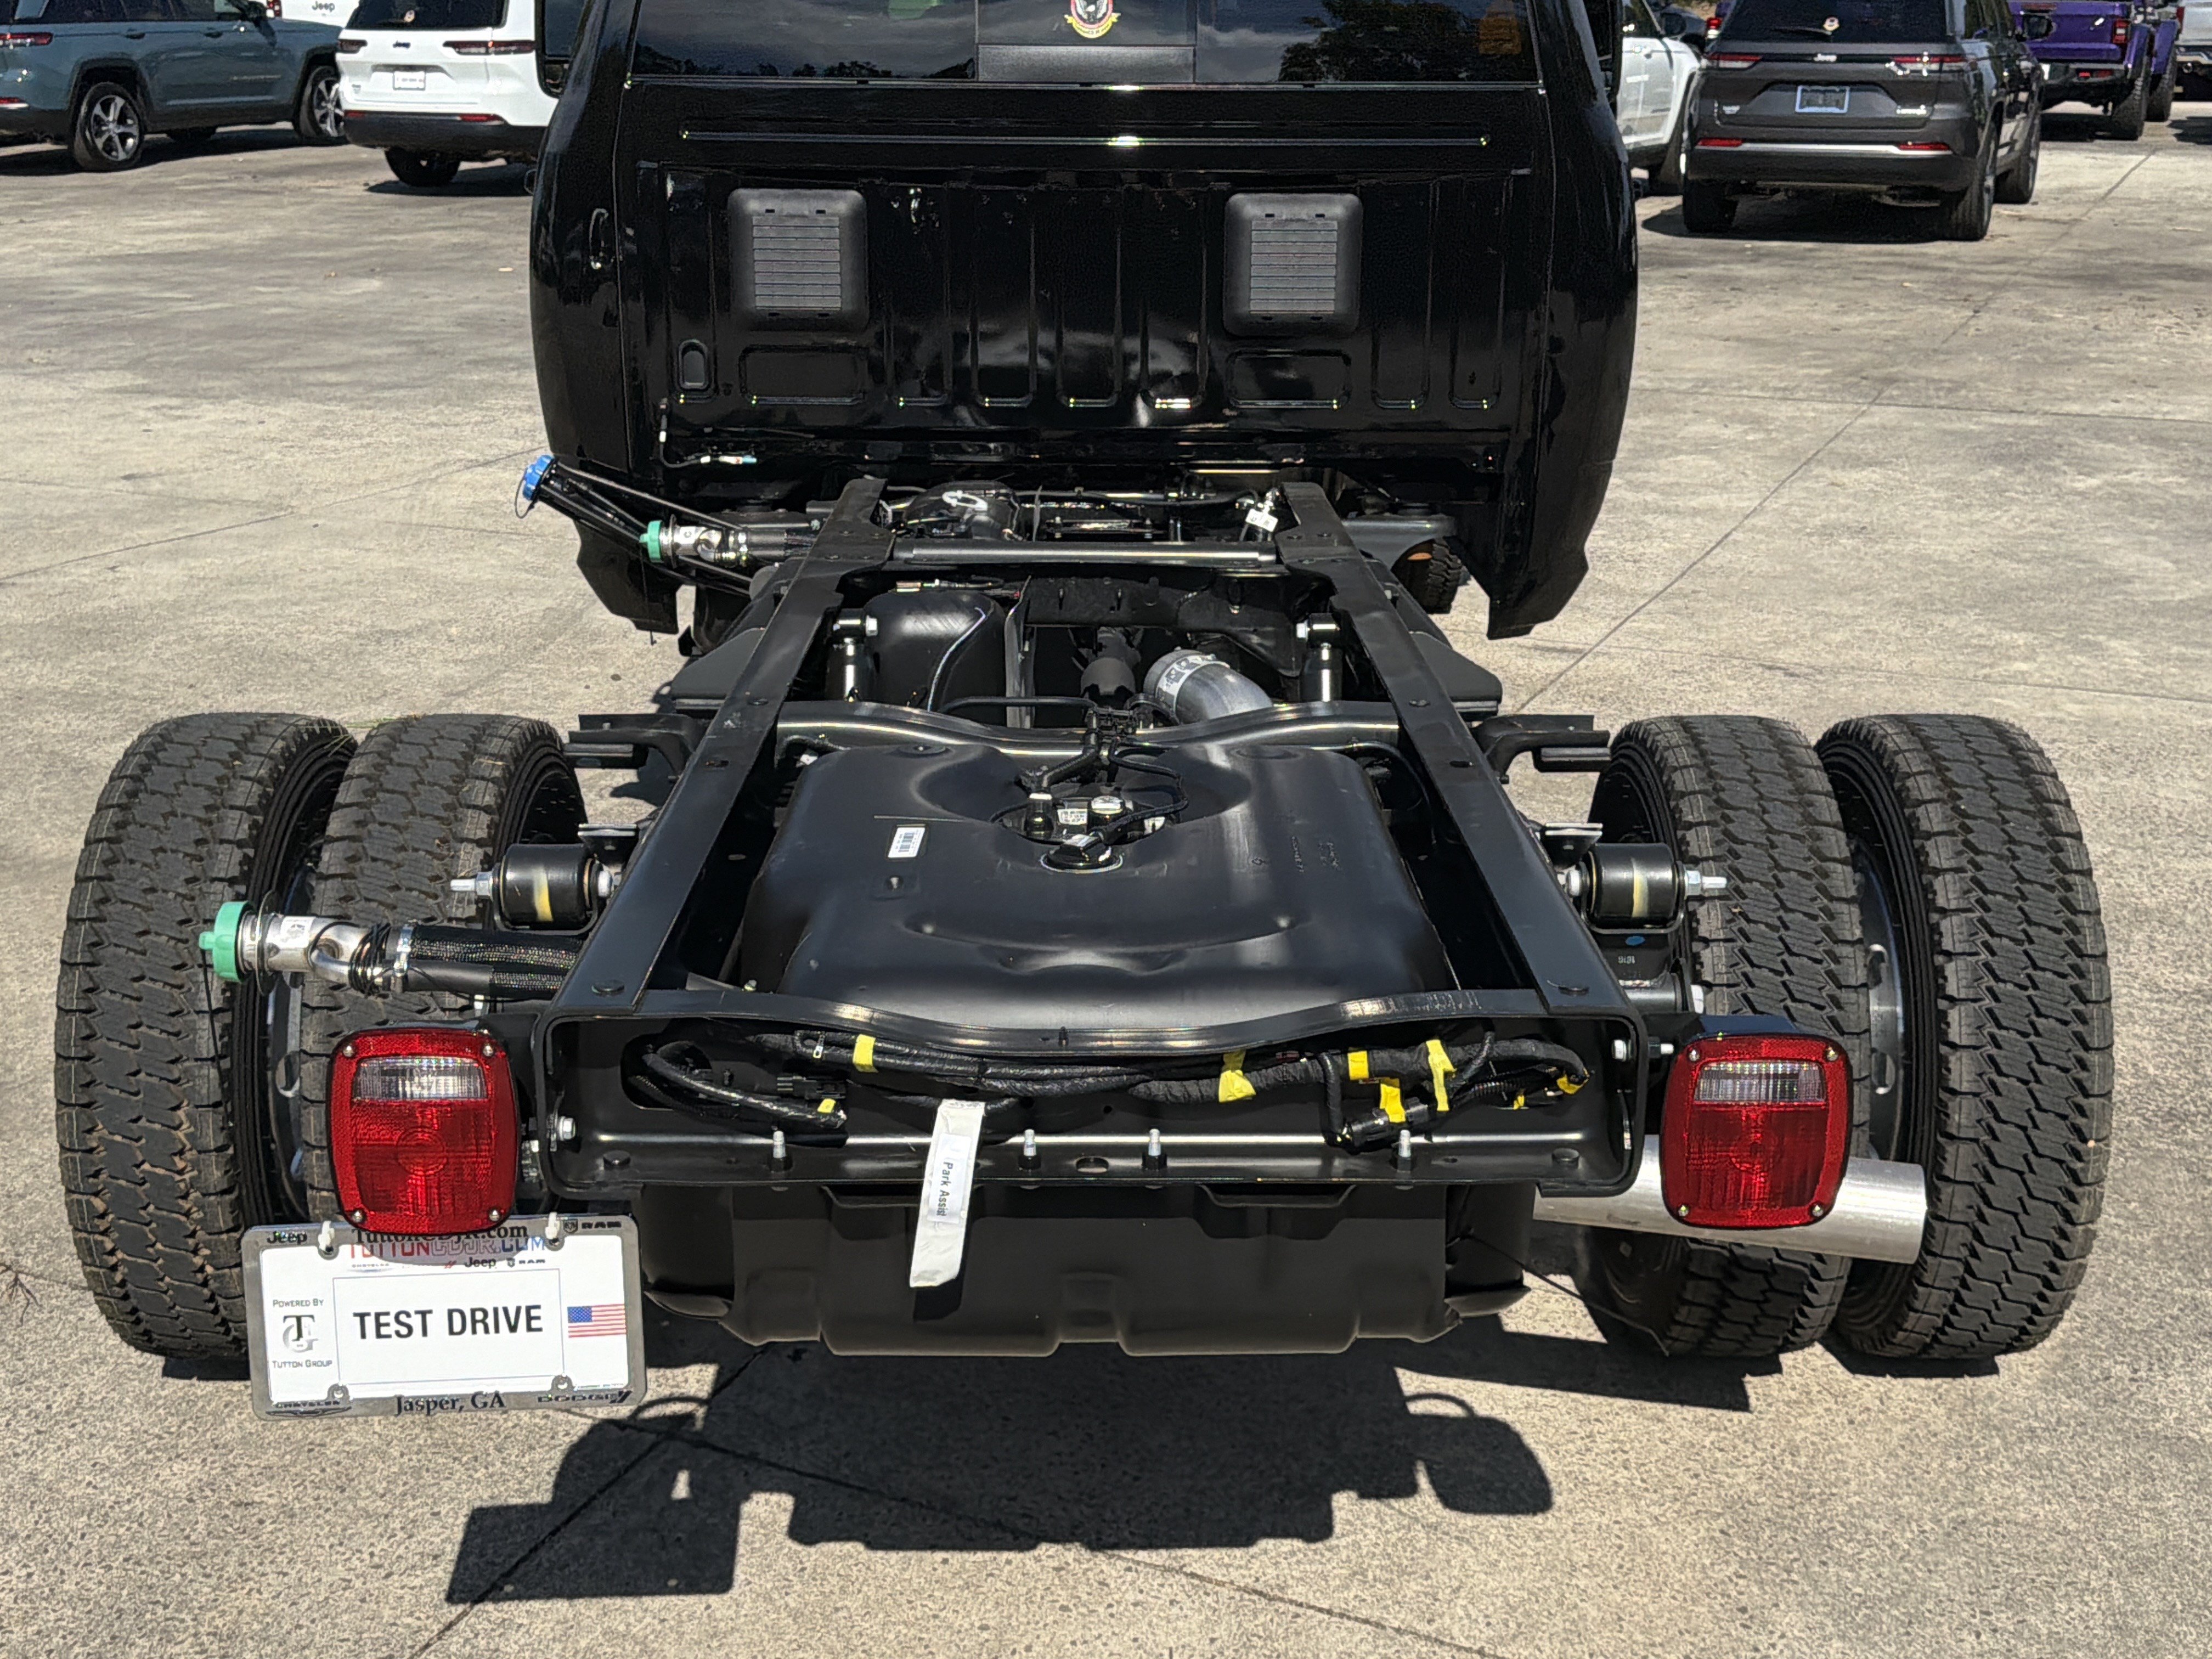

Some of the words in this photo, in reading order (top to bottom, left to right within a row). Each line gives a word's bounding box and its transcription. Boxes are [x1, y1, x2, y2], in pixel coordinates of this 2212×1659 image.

[312, 1, 335, 12] Jeep
[940, 1161, 953, 1186] Park
[581, 1221, 622, 1229] RAM
[267, 1230, 307, 1245] Jeep
[464, 1256, 496, 1269] Jeep
[353, 1308, 433, 1340] TEST
[447, 1304, 544, 1337] DRIVE
[393, 1394, 465, 1417] Jasper,
[470, 1390, 506, 1409] GA
